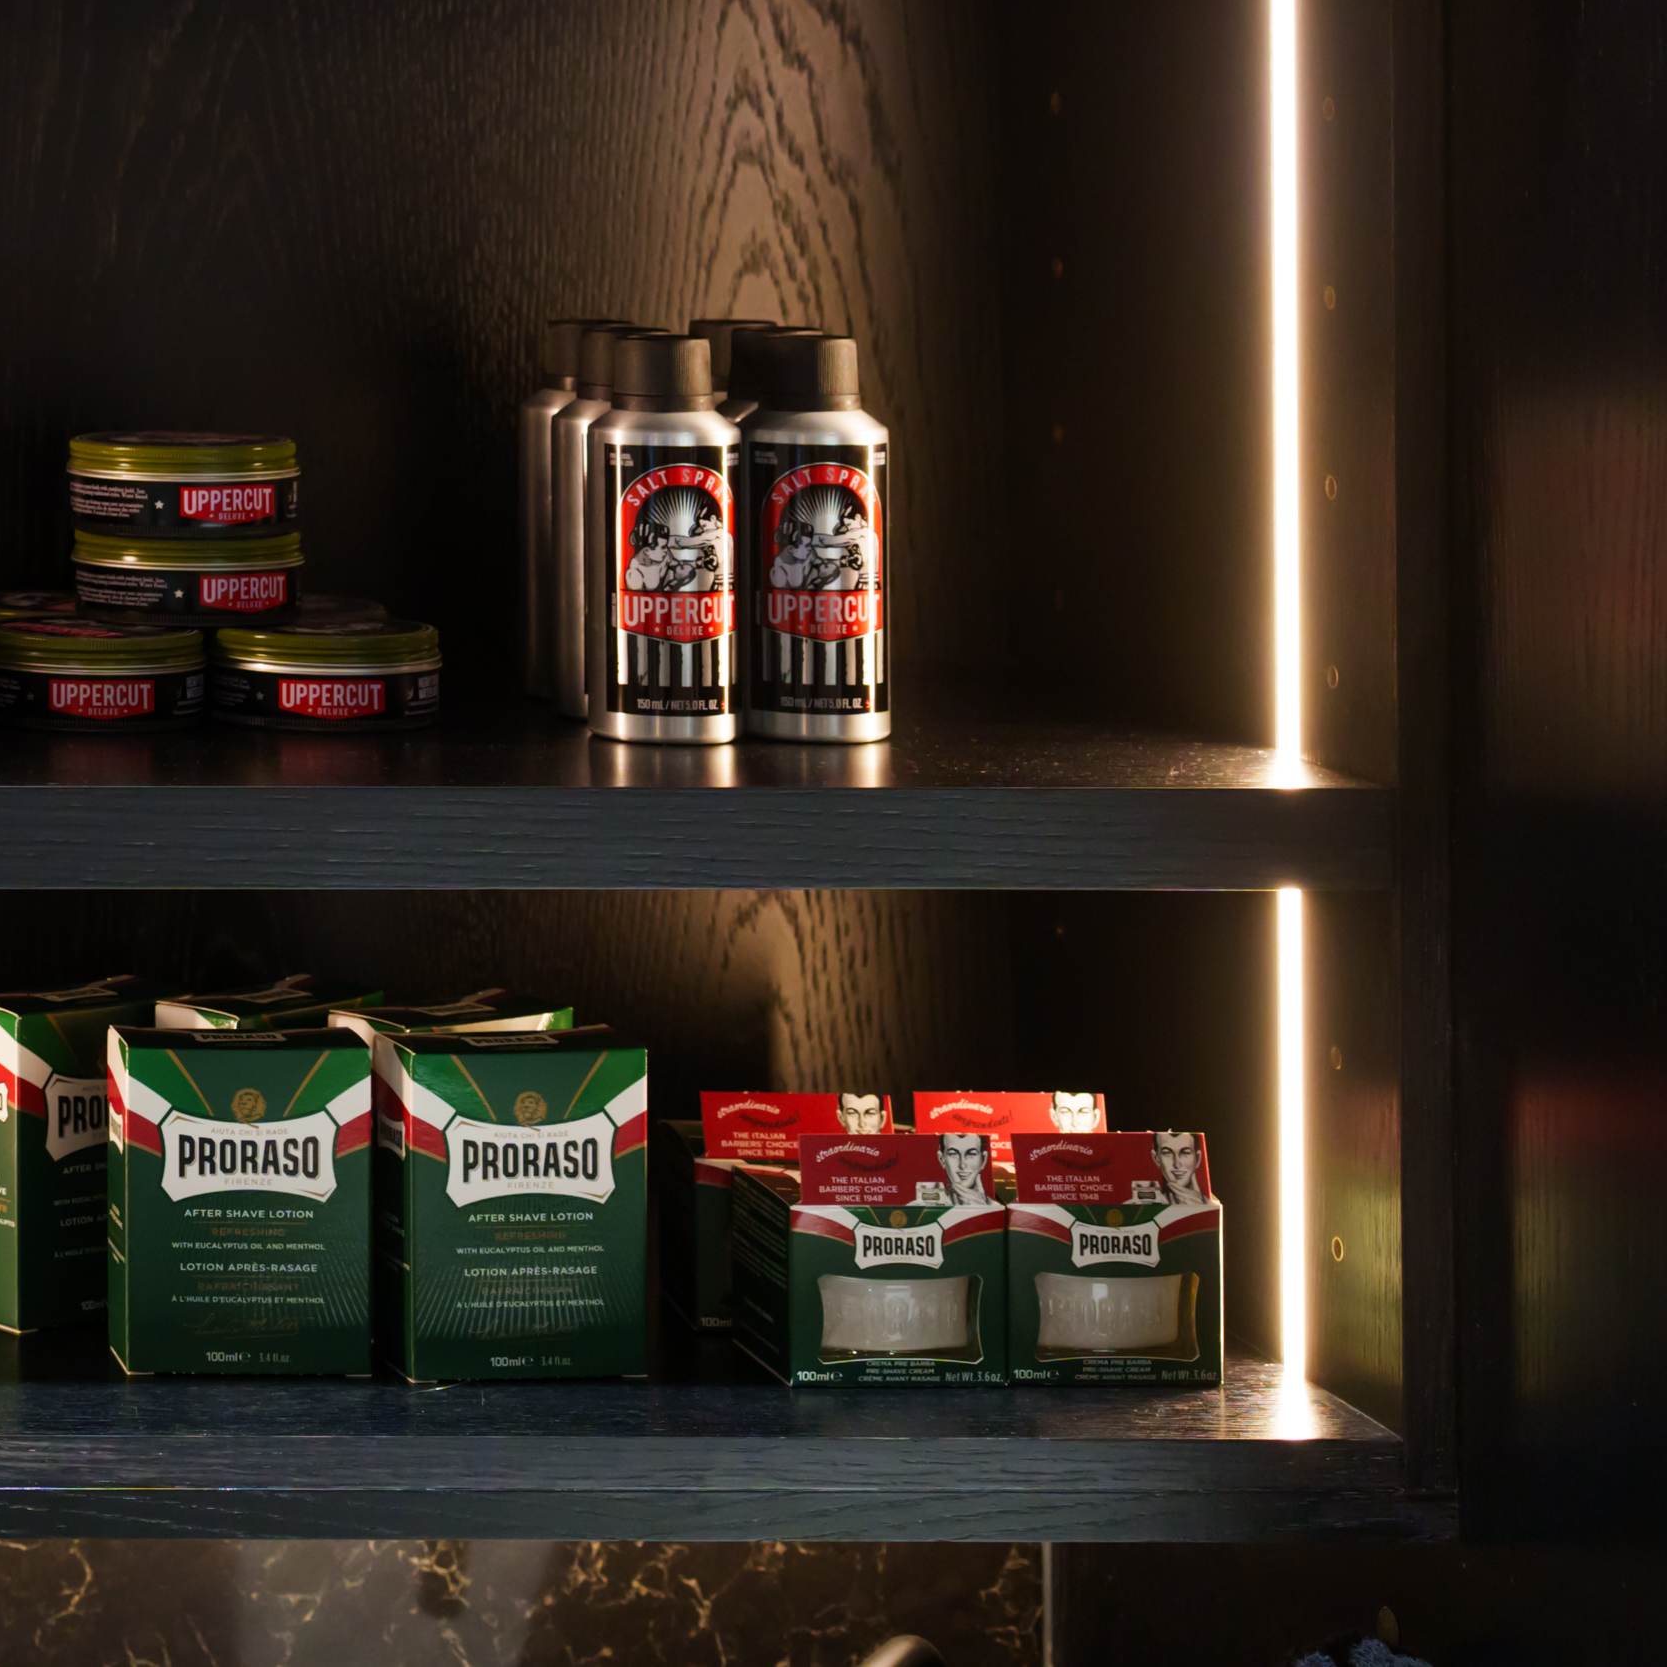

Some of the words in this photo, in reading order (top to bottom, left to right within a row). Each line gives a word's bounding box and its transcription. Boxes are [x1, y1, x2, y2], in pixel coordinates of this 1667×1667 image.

[627, 470, 667, 506] SALT
[771, 469, 812, 503] SALT
[183, 488, 272, 514] UPPERCUT
[203, 576, 285, 603] UPPERCUT
[624, 594, 734, 626] UPPERCUT
[768, 594, 880, 625] UPPERCUT
[52, 683, 151, 710] UPPERCUT
[282, 683, 381, 710] UPPERCUT
[179, 1134, 319, 1178] PRORASO
[463, 1138, 597, 1182] PRORASO
[816, 1142, 880, 1163] straordinario
[831, 1176, 848, 1184] THE
[849, 1176, 885, 1184] ITALIAN
[864, 1185, 898, 1193] CHOICE
[835, 1194, 861, 1202] SINCE
[863, 1194, 884, 1202] 1948
[184, 1209, 222, 1218] AFTER
[226, 1210, 265, 1218] SHAVE
[269, 1210, 314, 1219] LOTION
[468, 1214, 507, 1222] AFTER
[509, 1213, 546, 1222] SHAVE
[550, 1212, 593, 1221] LOTION
[863, 1235, 936, 1258] PRORASO
[1080, 1234, 1151, 1257] PRORASO
[180, 1263, 224, 1271] LOTION
[228, 1262, 318, 1272] APRÈS-RASAGE
[797, 1371, 829, 1382] 100ml
